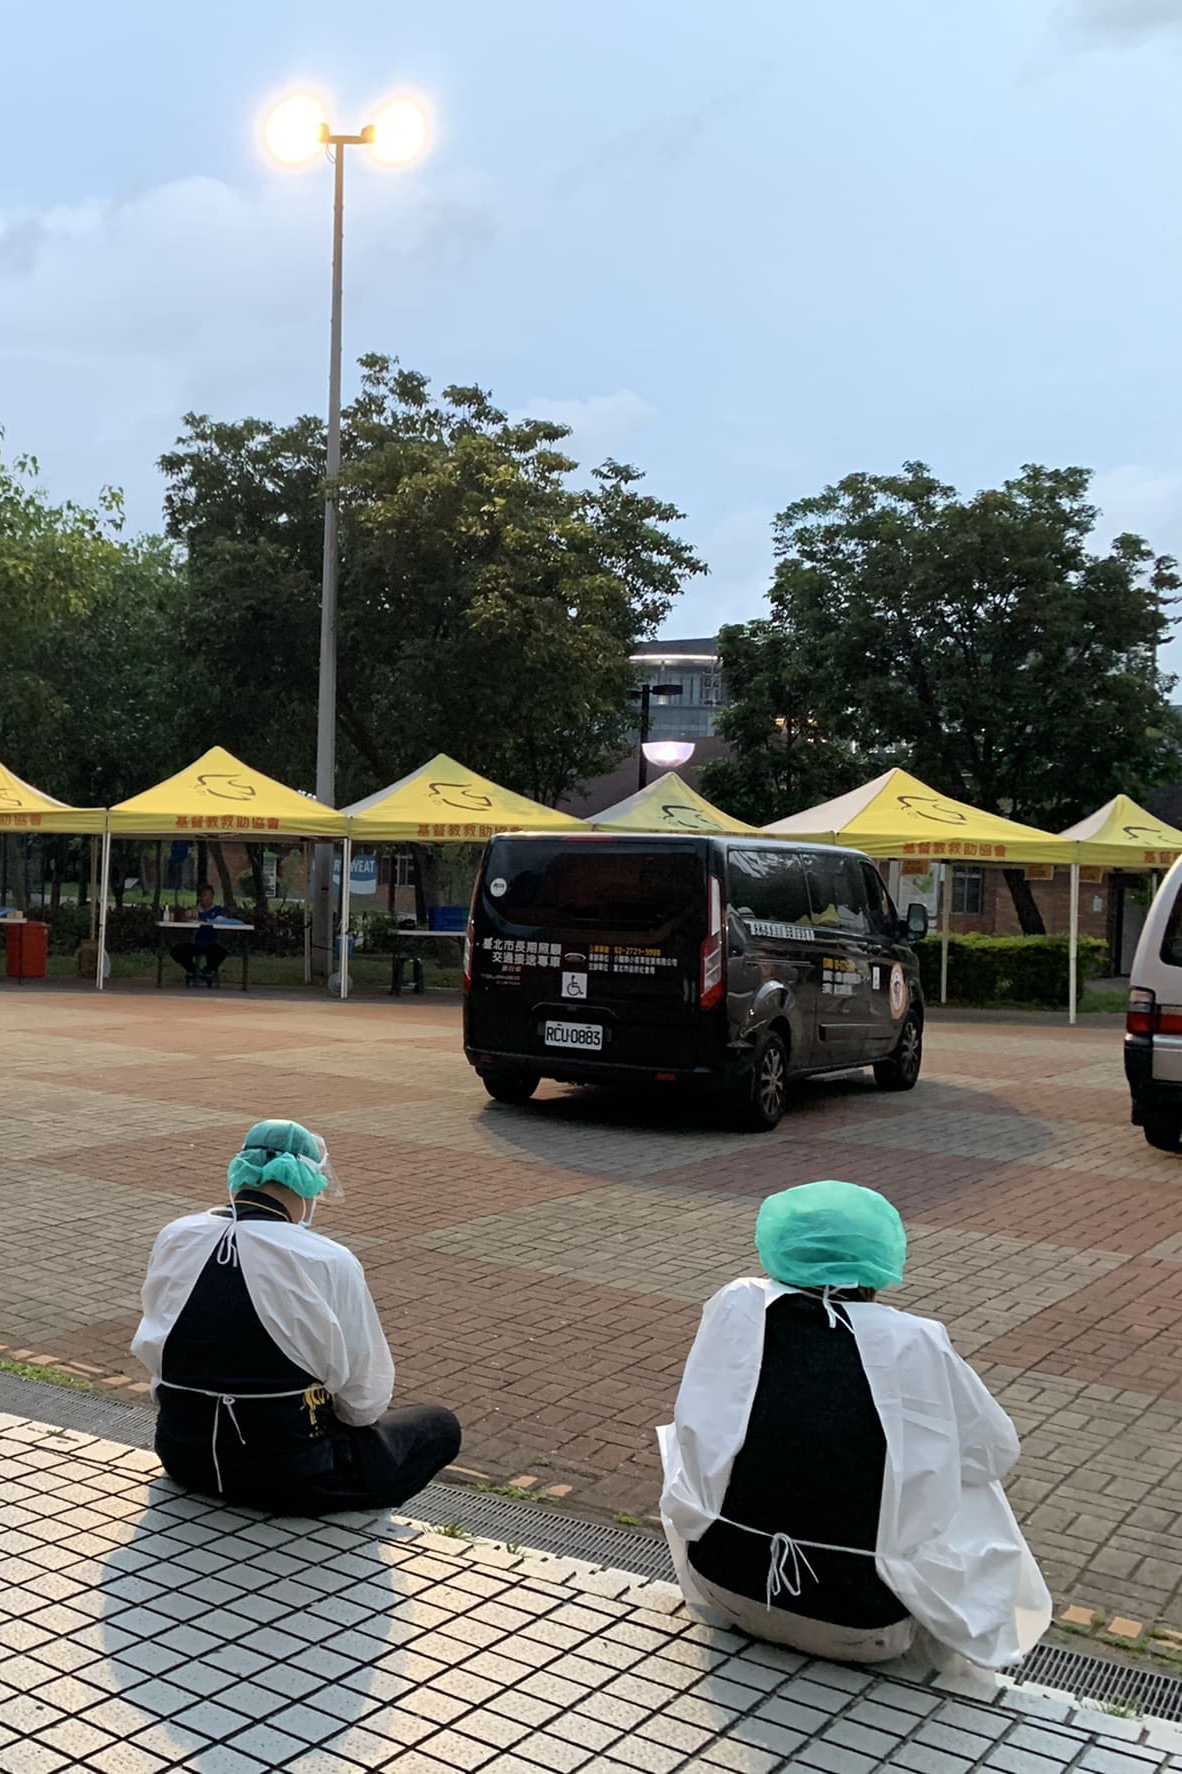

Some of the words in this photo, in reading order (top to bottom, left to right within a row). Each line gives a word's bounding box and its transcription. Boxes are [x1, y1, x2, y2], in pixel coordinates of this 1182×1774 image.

[176, 815, 280, 829] 基督教救助協會
[902, 841, 1008, 857] 基督教救助協會
[351, 860, 376, 873] WEAT
[492, 951, 561, 968] 交通接送專車
[546, 1026, 601, 1046] RCU-0883
